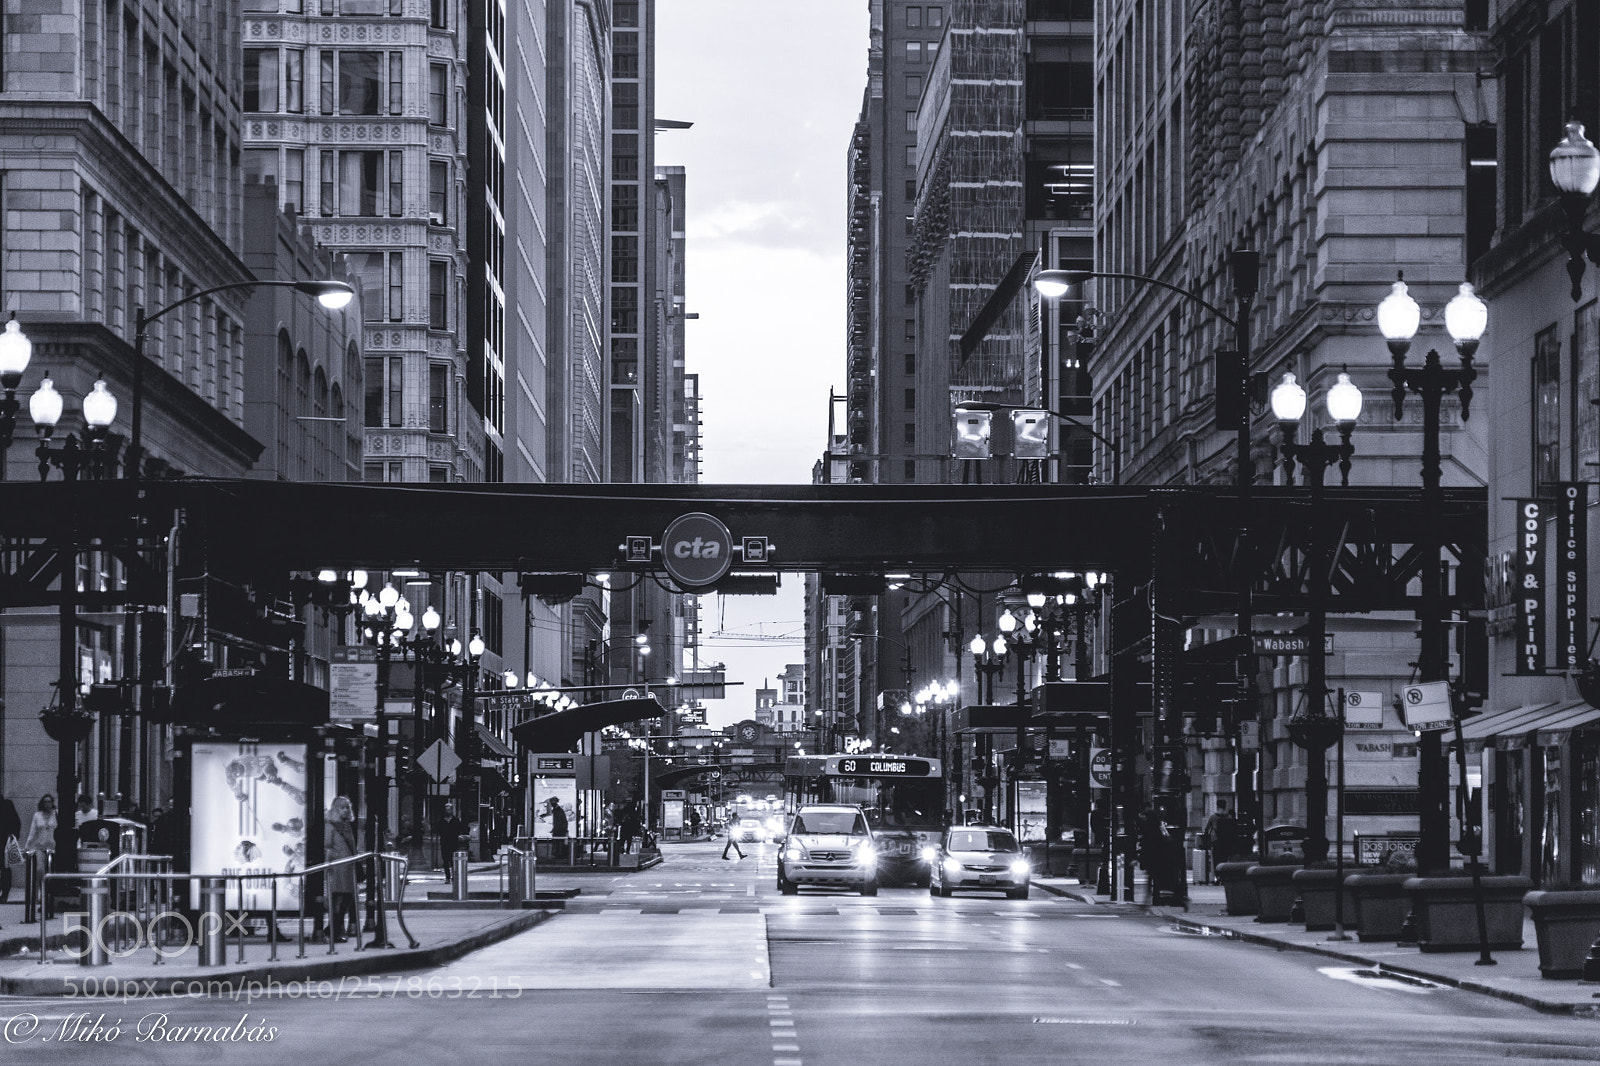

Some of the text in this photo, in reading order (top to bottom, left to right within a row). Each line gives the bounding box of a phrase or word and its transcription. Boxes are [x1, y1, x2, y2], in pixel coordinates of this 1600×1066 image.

[674, 536, 720, 559] cta
[1566, 487, 1578, 664] Office Supplies
[1523, 503, 1539, 670] Copy & Print
[1263, 639, 1304, 650] Wabash
[500, 696, 519, 704] State
[523, 695, 531, 703] St
[1430, 720, 1448, 728] ZONE
[1355, 743, 1391, 752] WABASH
[844, 760, 906, 772] 60 COLUMBUS
[1362, 841, 1416, 851] DOS TOROS
